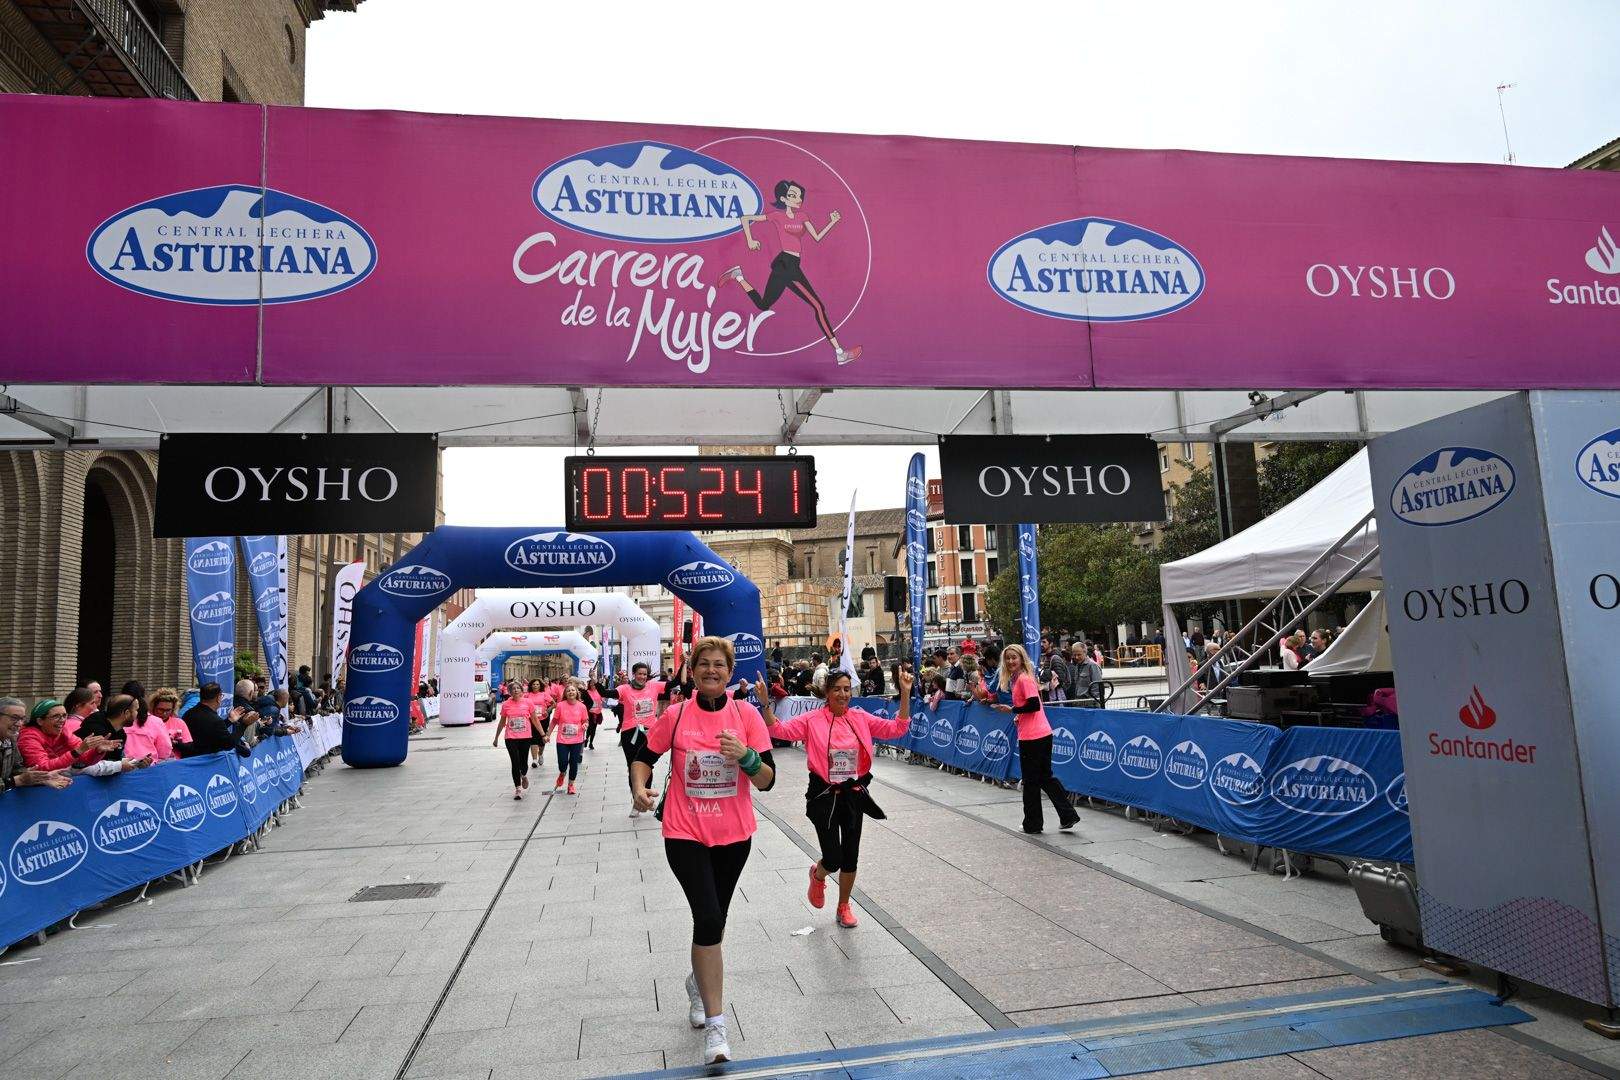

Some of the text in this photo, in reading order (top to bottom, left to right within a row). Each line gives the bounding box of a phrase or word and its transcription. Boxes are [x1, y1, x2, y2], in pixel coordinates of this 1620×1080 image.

[587, 173, 738, 189] CENTRAL LECHERA
[551, 175, 745, 219] ASTURIANA
[157, 225, 346, 240] CENTRAL LECHERA
[109, 227, 355, 275] ASTURIANA
[512, 232, 705, 290] Carrera
[1038, 252, 1181, 265] CENTRAL LECHERA
[1006, 254, 1190, 296] ASTURIANA
[1306, 263, 1456, 301] OYSHO
[1547, 278, 1620, 305] Santa
[561, 286, 775, 374] de la Mujer
[978, 464, 1131, 497] OYSHO
[1413, 463, 1498, 489] CENTRAL LECHERA
[1588, 453, 1620, 482] AS
[204, 466, 399, 502] OYSHO
[1399, 474, 1506, 515] ASTURIANA
[513, 545, 607, 565] ASTURIANA
[383, 577, 446, 590] ASTURIANA
[671, 572, 731, 585] ASTURIANA
[510, 599, 597, 619] OYSHO
[1403, 579, 1530, 621] OYSHO
[456, 621, 486, 629] OYSHO
[351, 654, 400, 666] ASTURIANA
[346, 707, 395, 719] ASTURIANA
[1080, 745, 1113, 763] ASTURIANA
[1120, 750, 1158, 770] ASTURIANA
[1428, 733, 1537, 764] Santander
[1277, 775, 1368, 803] ASTURIANA
[168, 803, 205, 825] ASTURIANA
[99, 817, 158, 847] ASTURIANA
[17, 840, 85, 877] ASTURIANA
